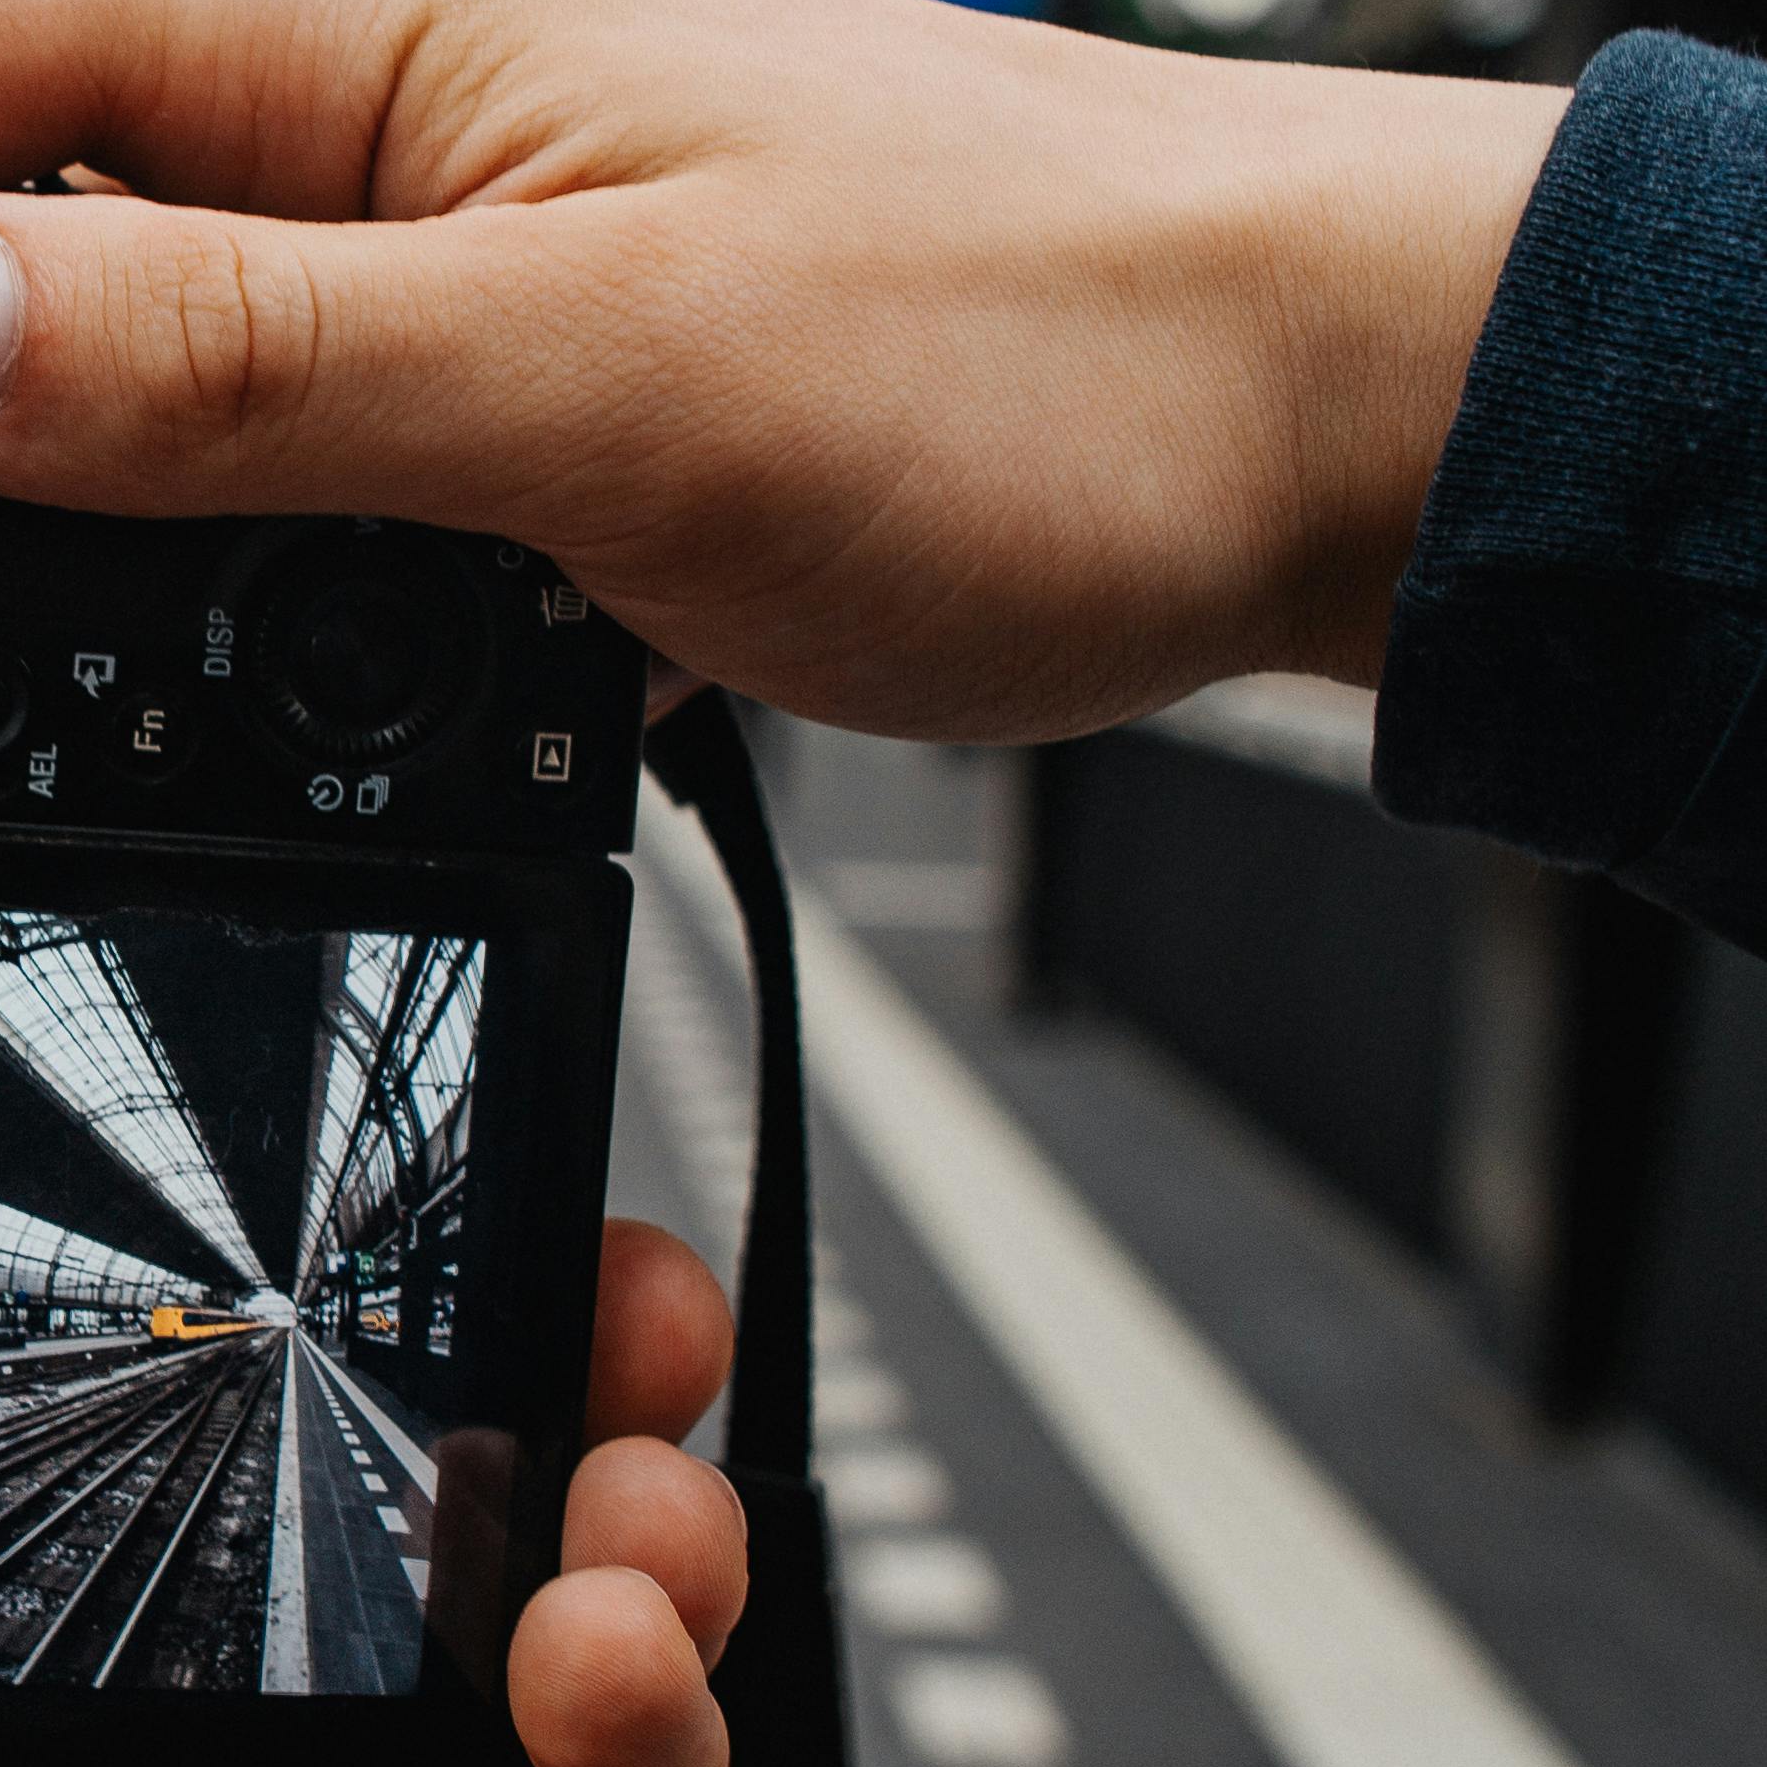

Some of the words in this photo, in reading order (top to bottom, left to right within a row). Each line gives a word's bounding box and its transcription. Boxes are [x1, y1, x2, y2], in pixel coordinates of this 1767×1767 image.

[204, 605, 234, 677] DISP
[133, 708, 166, 754] Fn
[27, 742, 58, 799] AEL
